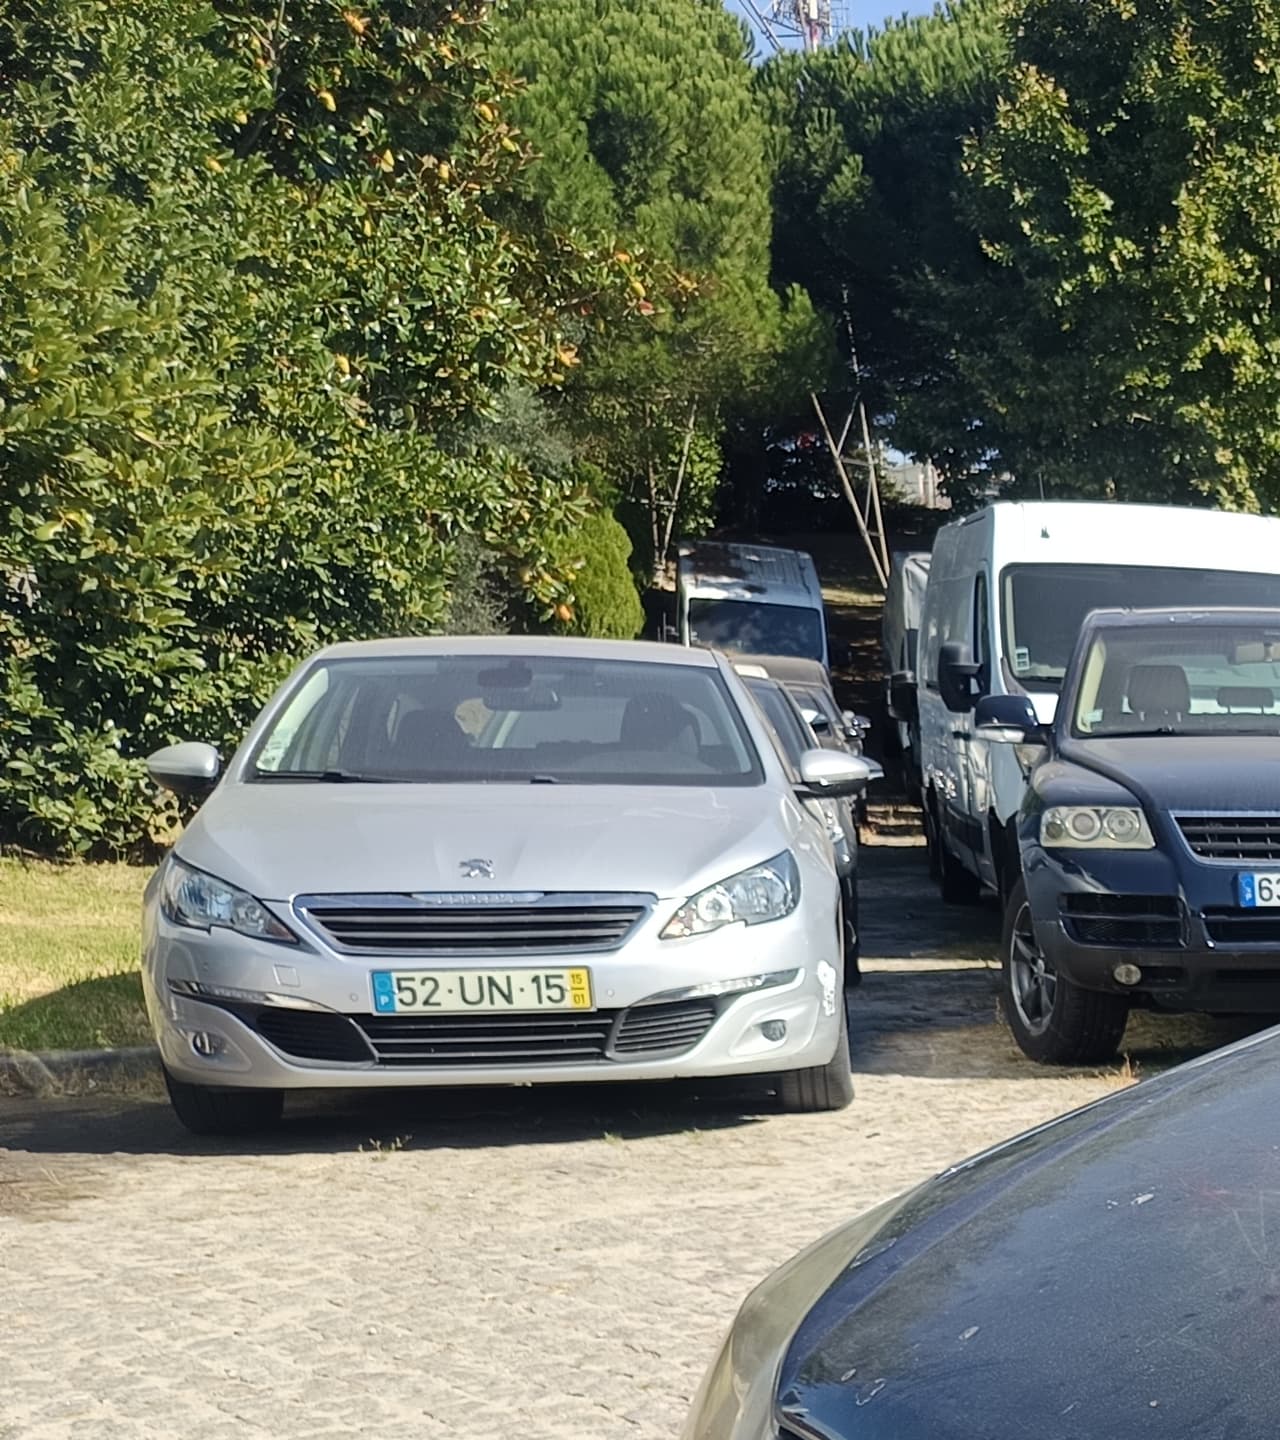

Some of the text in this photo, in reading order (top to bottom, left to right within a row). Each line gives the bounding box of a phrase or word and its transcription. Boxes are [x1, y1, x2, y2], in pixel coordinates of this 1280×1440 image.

[571, 974, 583, 984] 15
[380, 994, 390, 1006] P
[573, 993, 585, 1004] 01
